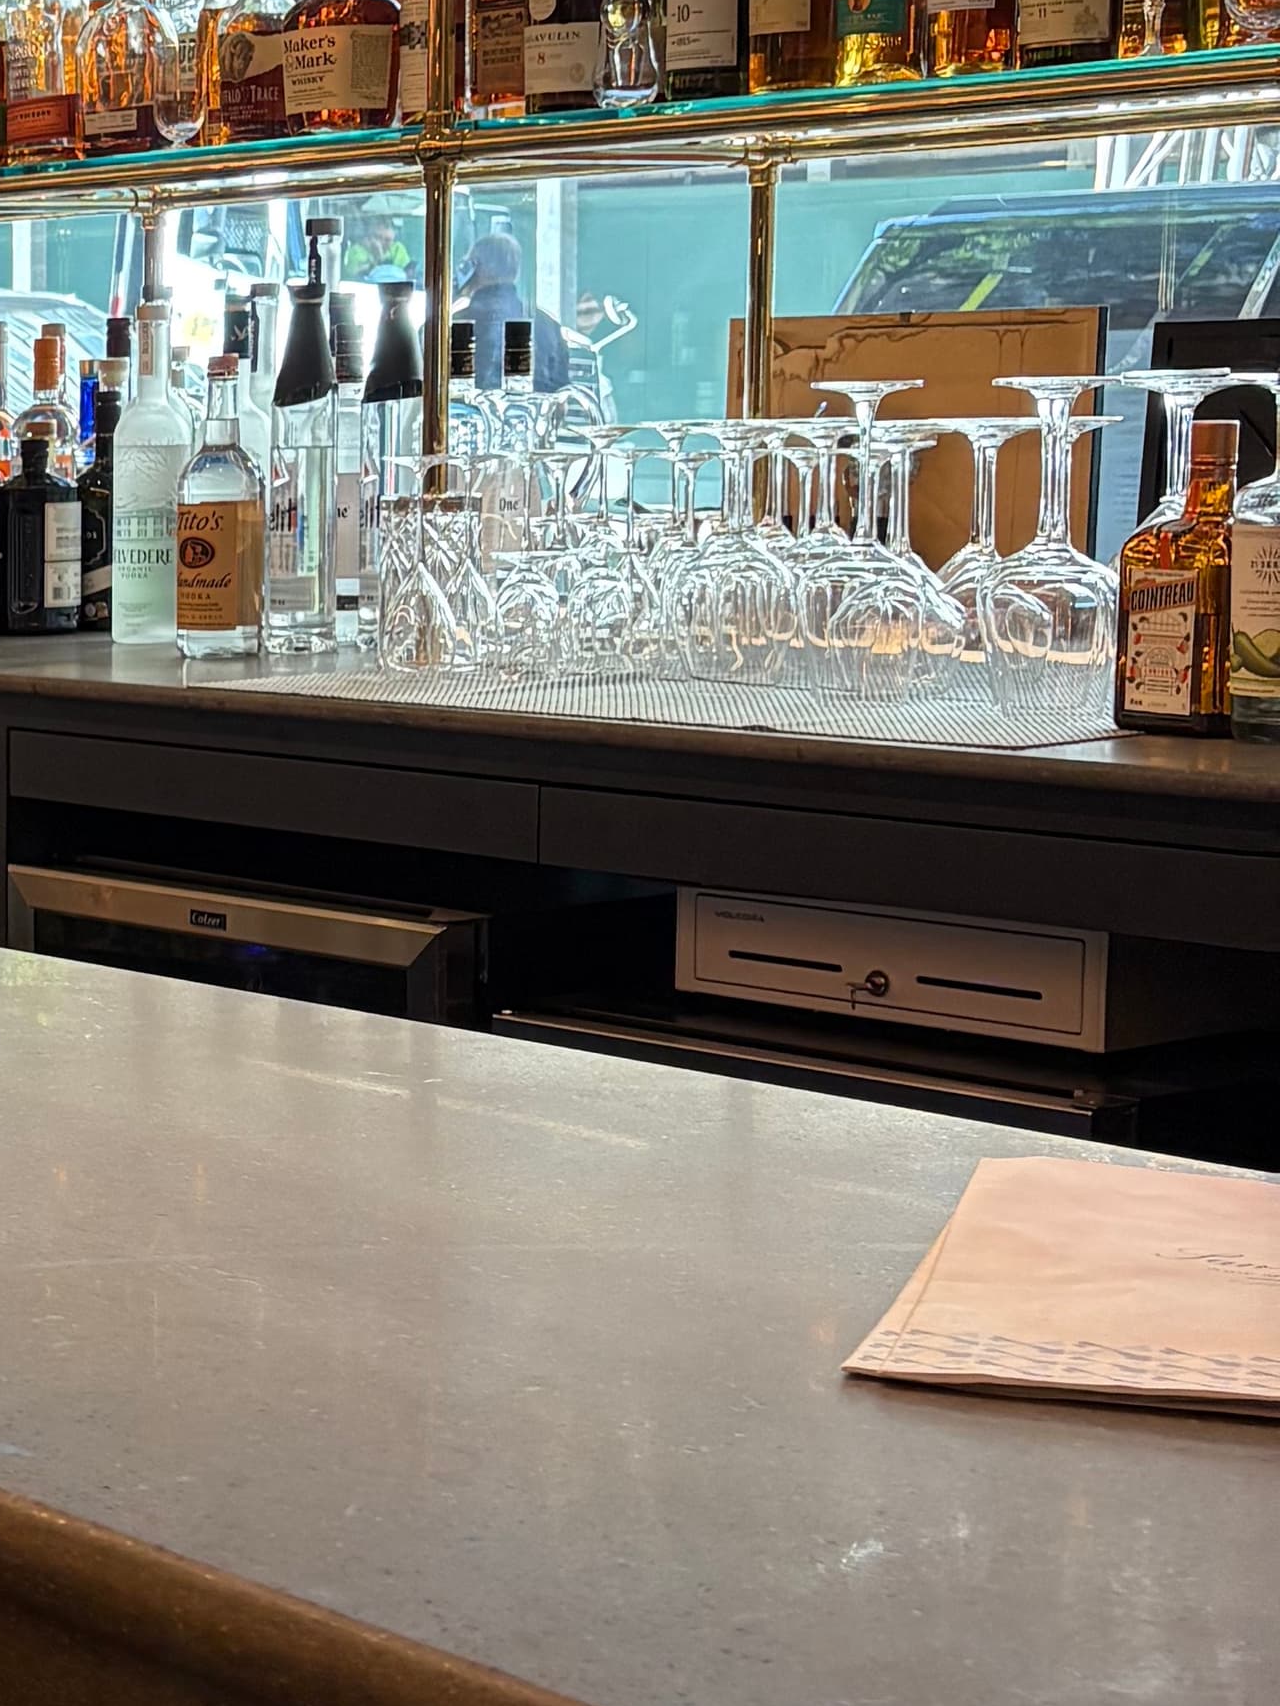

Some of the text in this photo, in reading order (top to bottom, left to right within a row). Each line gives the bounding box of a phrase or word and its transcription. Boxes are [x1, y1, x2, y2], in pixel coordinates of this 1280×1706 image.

[283, 34, 336, 54] Maker's
[295, 52, 337, 70] Mark
[178, 509, 224, 532] Tito's
[1131, 580, 1195, 613] COINTREAU
